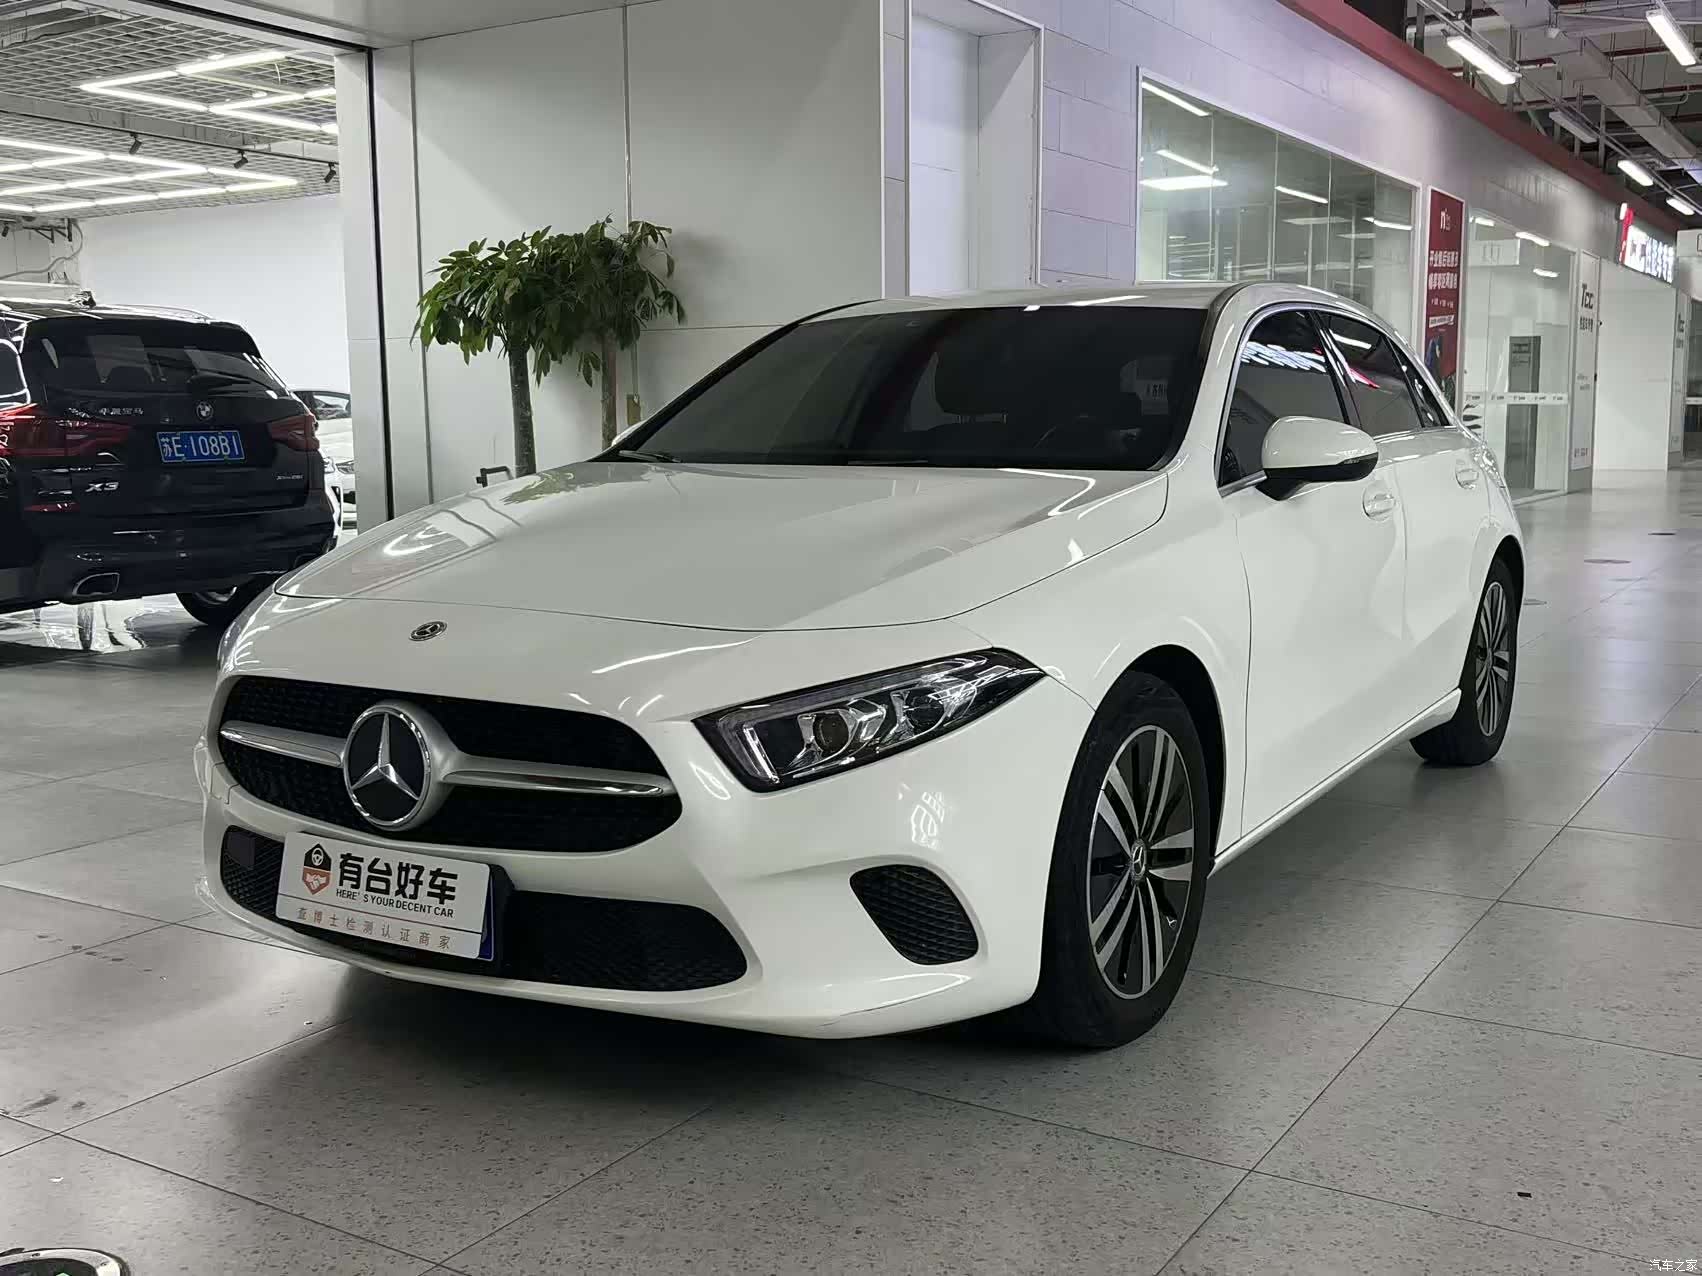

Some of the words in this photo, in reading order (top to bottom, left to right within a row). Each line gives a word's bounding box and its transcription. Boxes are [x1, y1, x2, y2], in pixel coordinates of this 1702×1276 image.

[85, 481, 119, 493] X3
[338, 852, 459, 905] 有台好车
[370, 895, 395, 908] YOUR
[396, 899, 433, 914] DECENT
[434, 906, 454, 918] CAR
